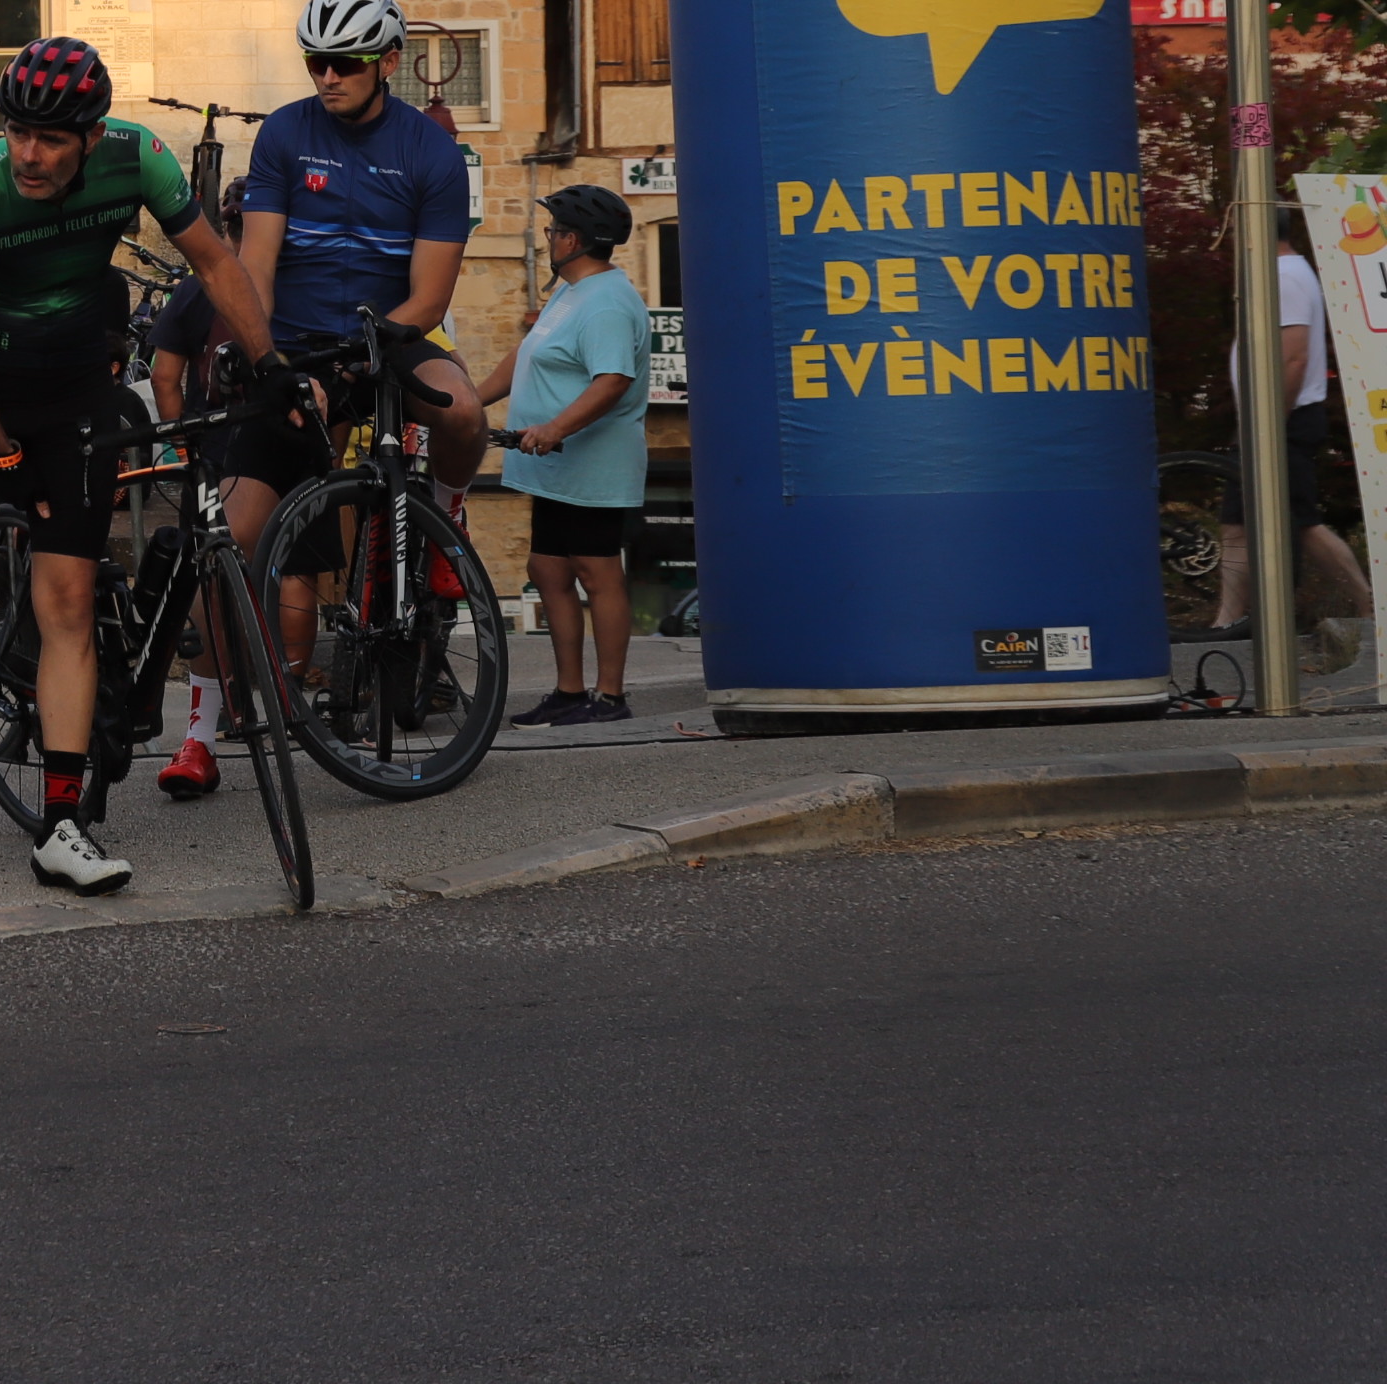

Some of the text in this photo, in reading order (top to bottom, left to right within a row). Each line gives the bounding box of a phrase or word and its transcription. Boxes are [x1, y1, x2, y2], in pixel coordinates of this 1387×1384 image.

[65, 213, 96, 234] FELICE
[98, 204, 136, 225] GIMONDI
[776, 170, 1143, 236] PARTENAIRE
[824, 253, 1134, 315] DE VOTRE
[791, 325, 1150, 400] ÉVÈNEMENT
